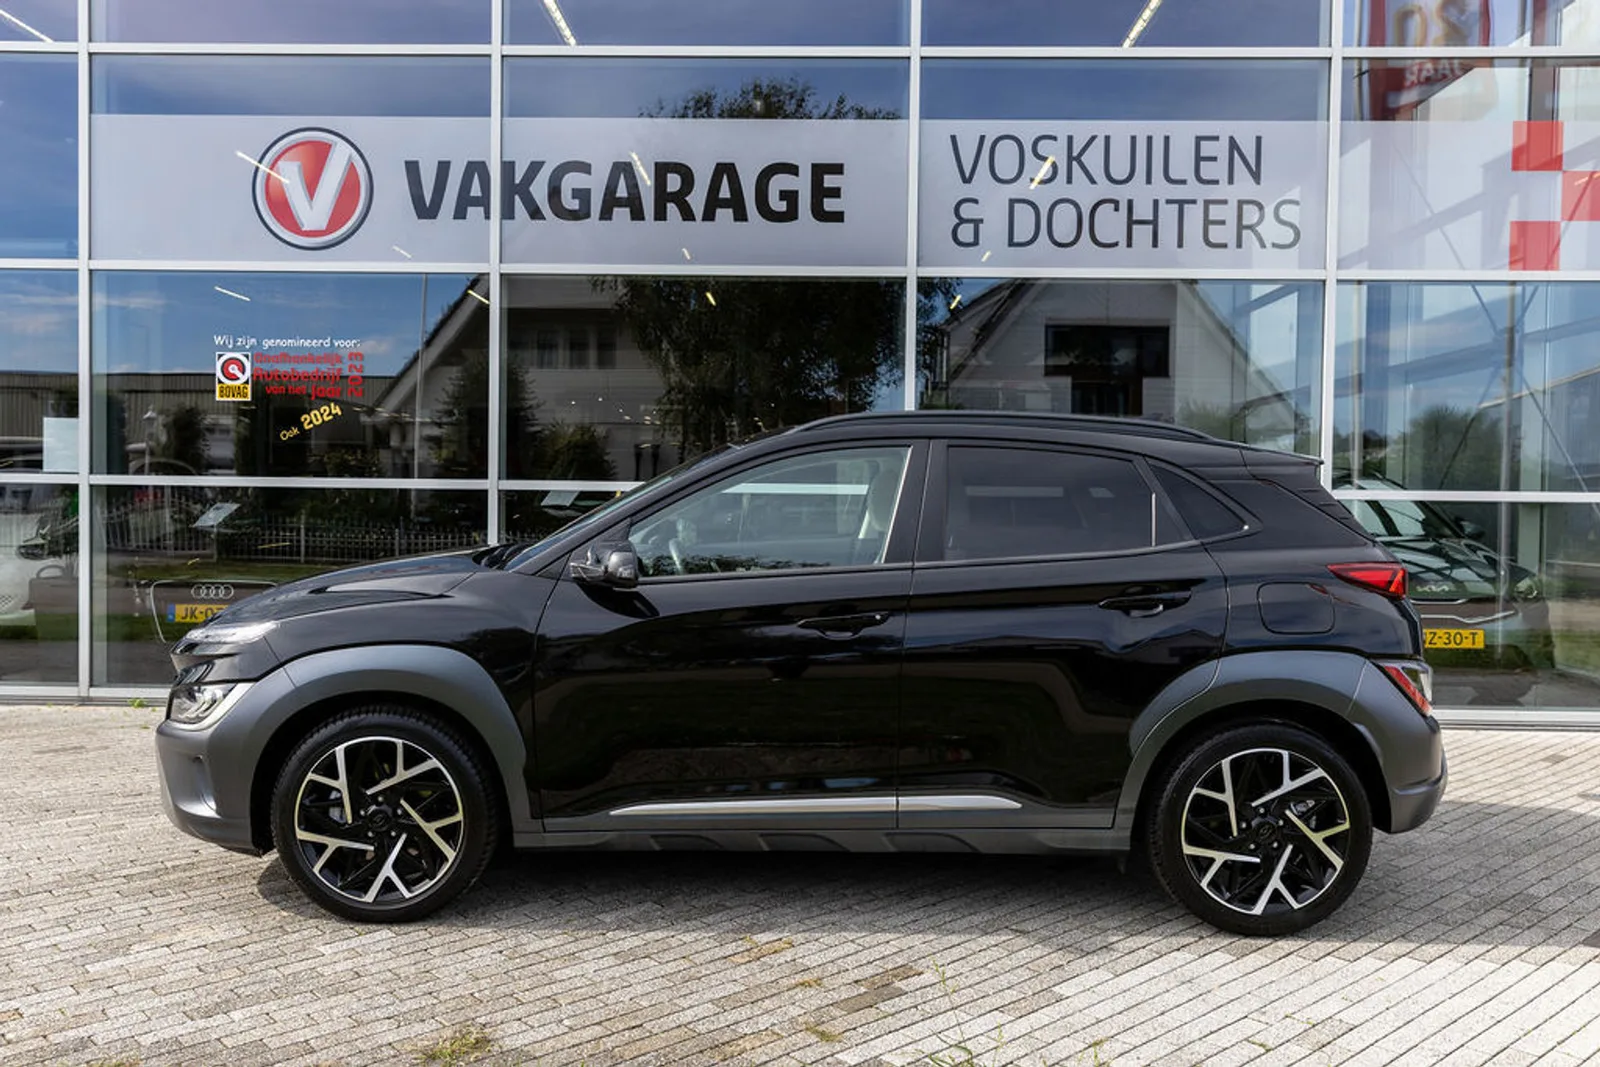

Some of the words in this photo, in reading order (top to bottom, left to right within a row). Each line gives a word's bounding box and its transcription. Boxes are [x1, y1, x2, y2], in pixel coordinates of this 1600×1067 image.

[950, 134, 1262, 187] VOSKUILEN
[404, 160, 845, 222] VAKGARAGE
[951, 197, 984, 247] &
[1008, 197, 1302, 250] DOCHTERS
[213, 335, 234, 349] Wij
[236, 336, 258, 349] zijn
[262, 336, 331, 350] genomineerd
[333, 338, 361, 348] voor:
[253, 352, 343, 366] Onafhankelijk
[253, 366, 343, 384] Autobedrijf
[348, 352, 364, 397] 2023
[218, 385, 249, 399] BOVAG
[265, 385, 285, 395] van
[288, 384, 307, 395] het
[279, 426, 300, 441] Ook
[301, 402, 342, 430] 2024
[1424, 631, 1478, 646] Z-30-T
